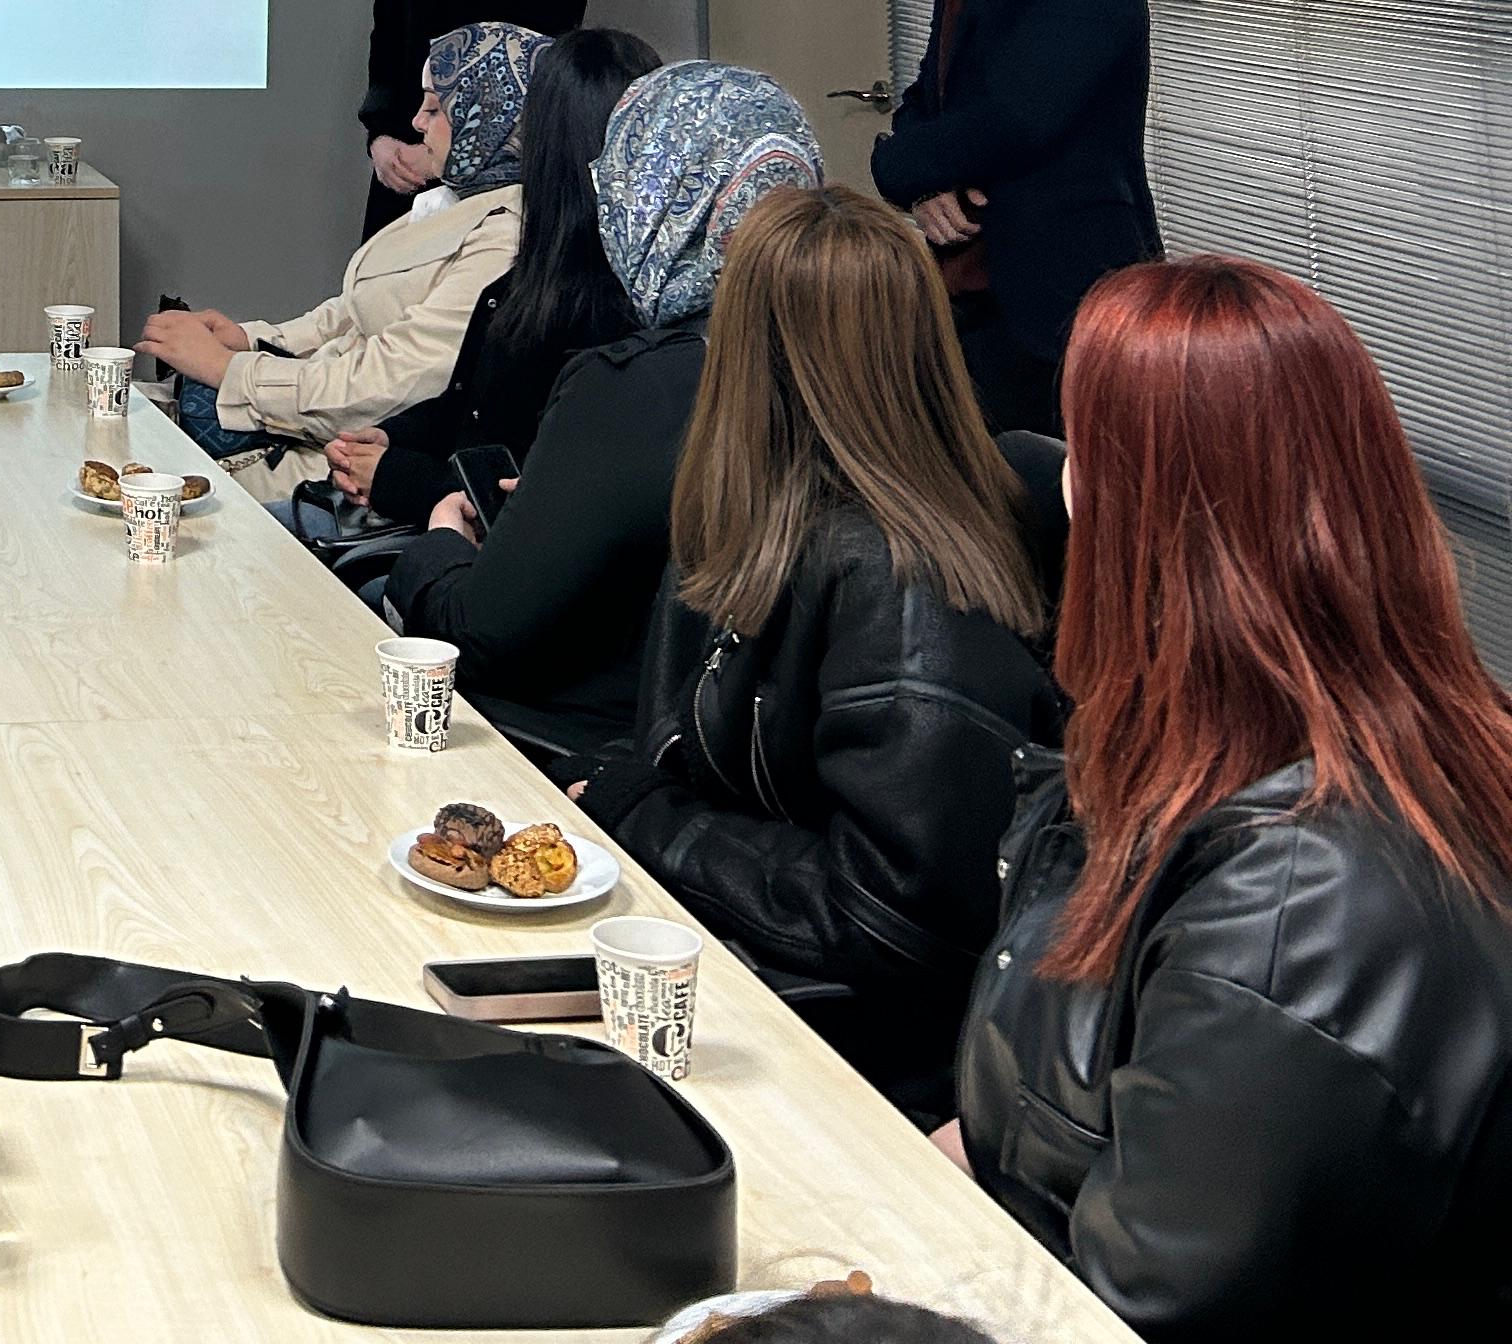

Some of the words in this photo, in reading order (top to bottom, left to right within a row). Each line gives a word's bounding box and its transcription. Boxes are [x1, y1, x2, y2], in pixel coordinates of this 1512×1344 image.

[134, 506, 163, 520] hot
[431, 678, 445, 708] CAFE
[674, 980, 689, 1021] CAFE
